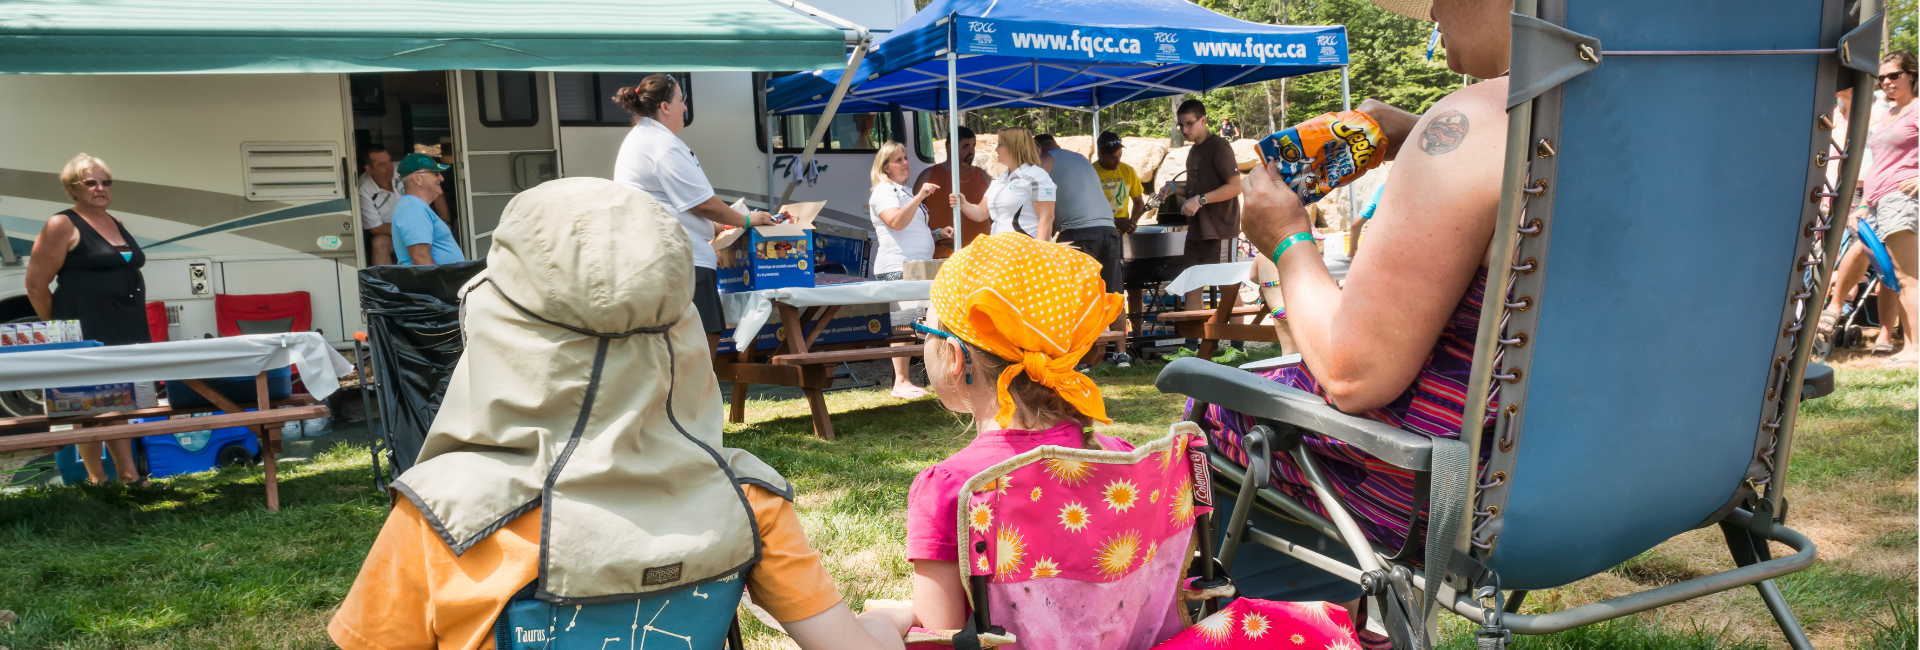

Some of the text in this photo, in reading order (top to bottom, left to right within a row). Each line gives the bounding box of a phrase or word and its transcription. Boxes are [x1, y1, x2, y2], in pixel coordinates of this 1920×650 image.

[1011, 29, 1141, 58] www.fqcc.ca
[1192, 37, 1307, 64] www.fqcc.ca
[870, 321, 879, 329] 50
[1194, 463, 1207, 498] Coleman
[515, 626, 546, 643] Taurus
